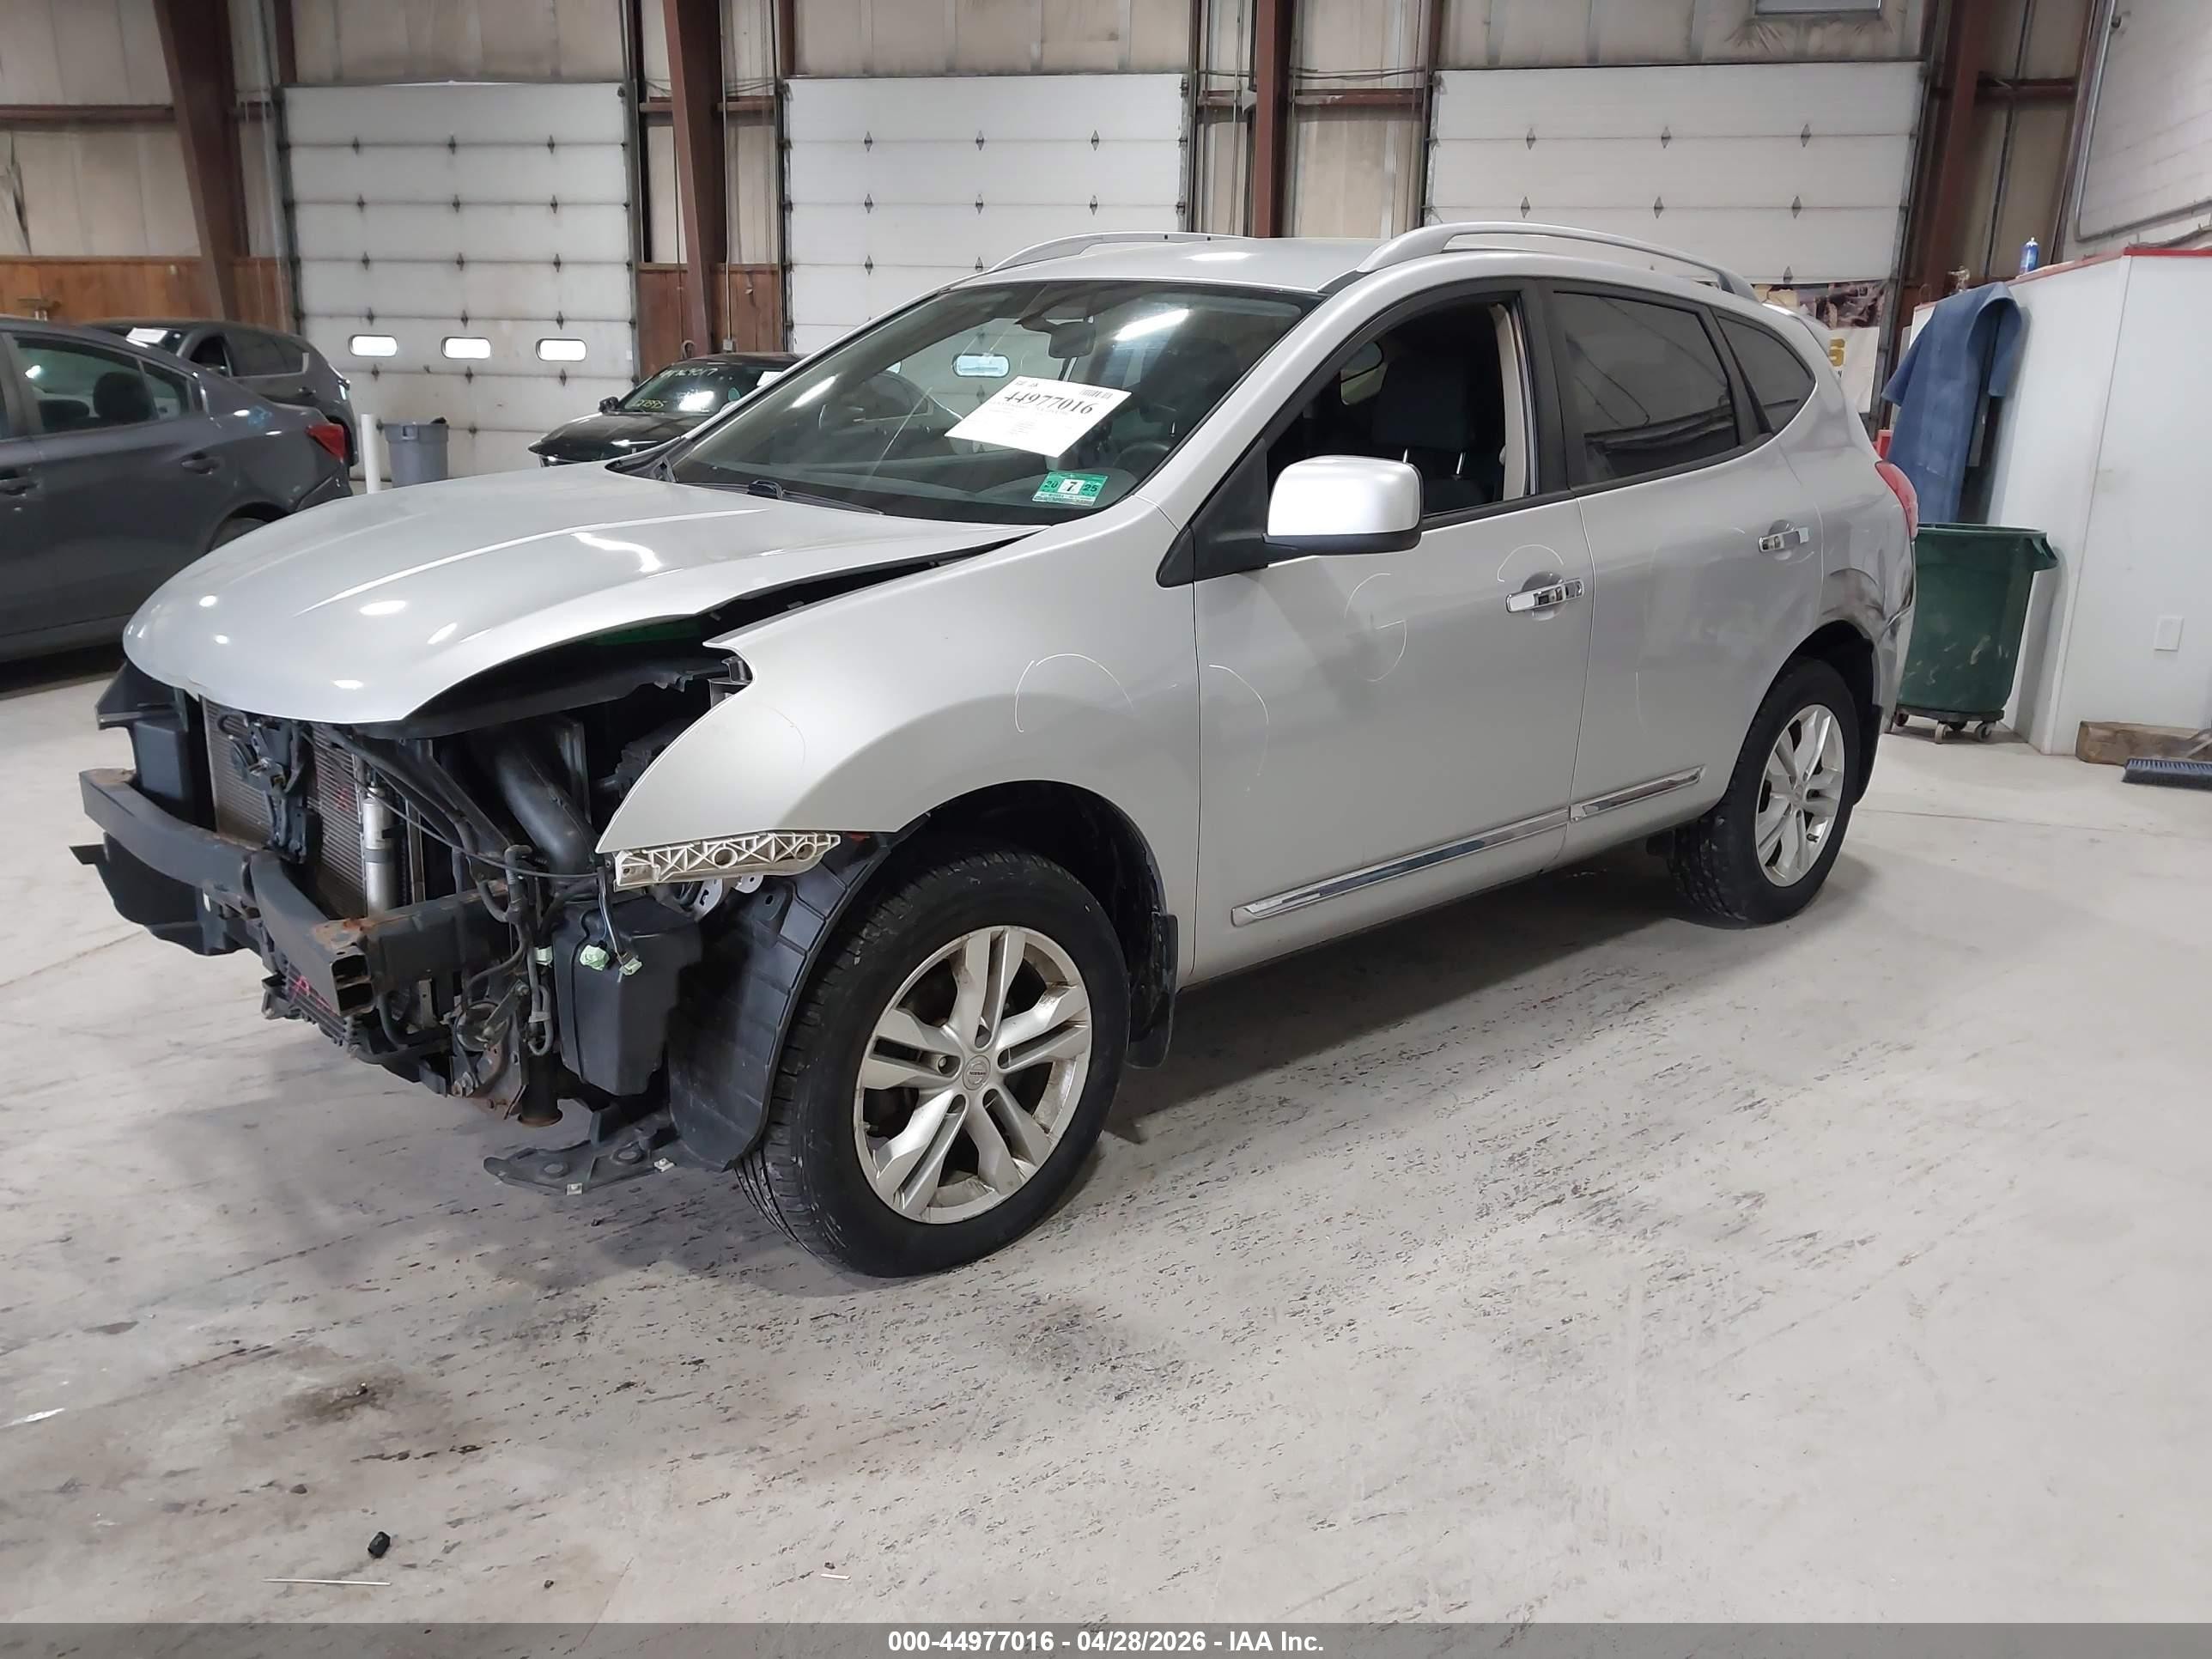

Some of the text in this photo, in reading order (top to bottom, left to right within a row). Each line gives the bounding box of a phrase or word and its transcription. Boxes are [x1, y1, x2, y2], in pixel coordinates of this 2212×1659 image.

[1004, 391, 1099, 415] 44977016
[1066, 481, 1078, 492] 7
[1083, 483, 1098, 492] 25
